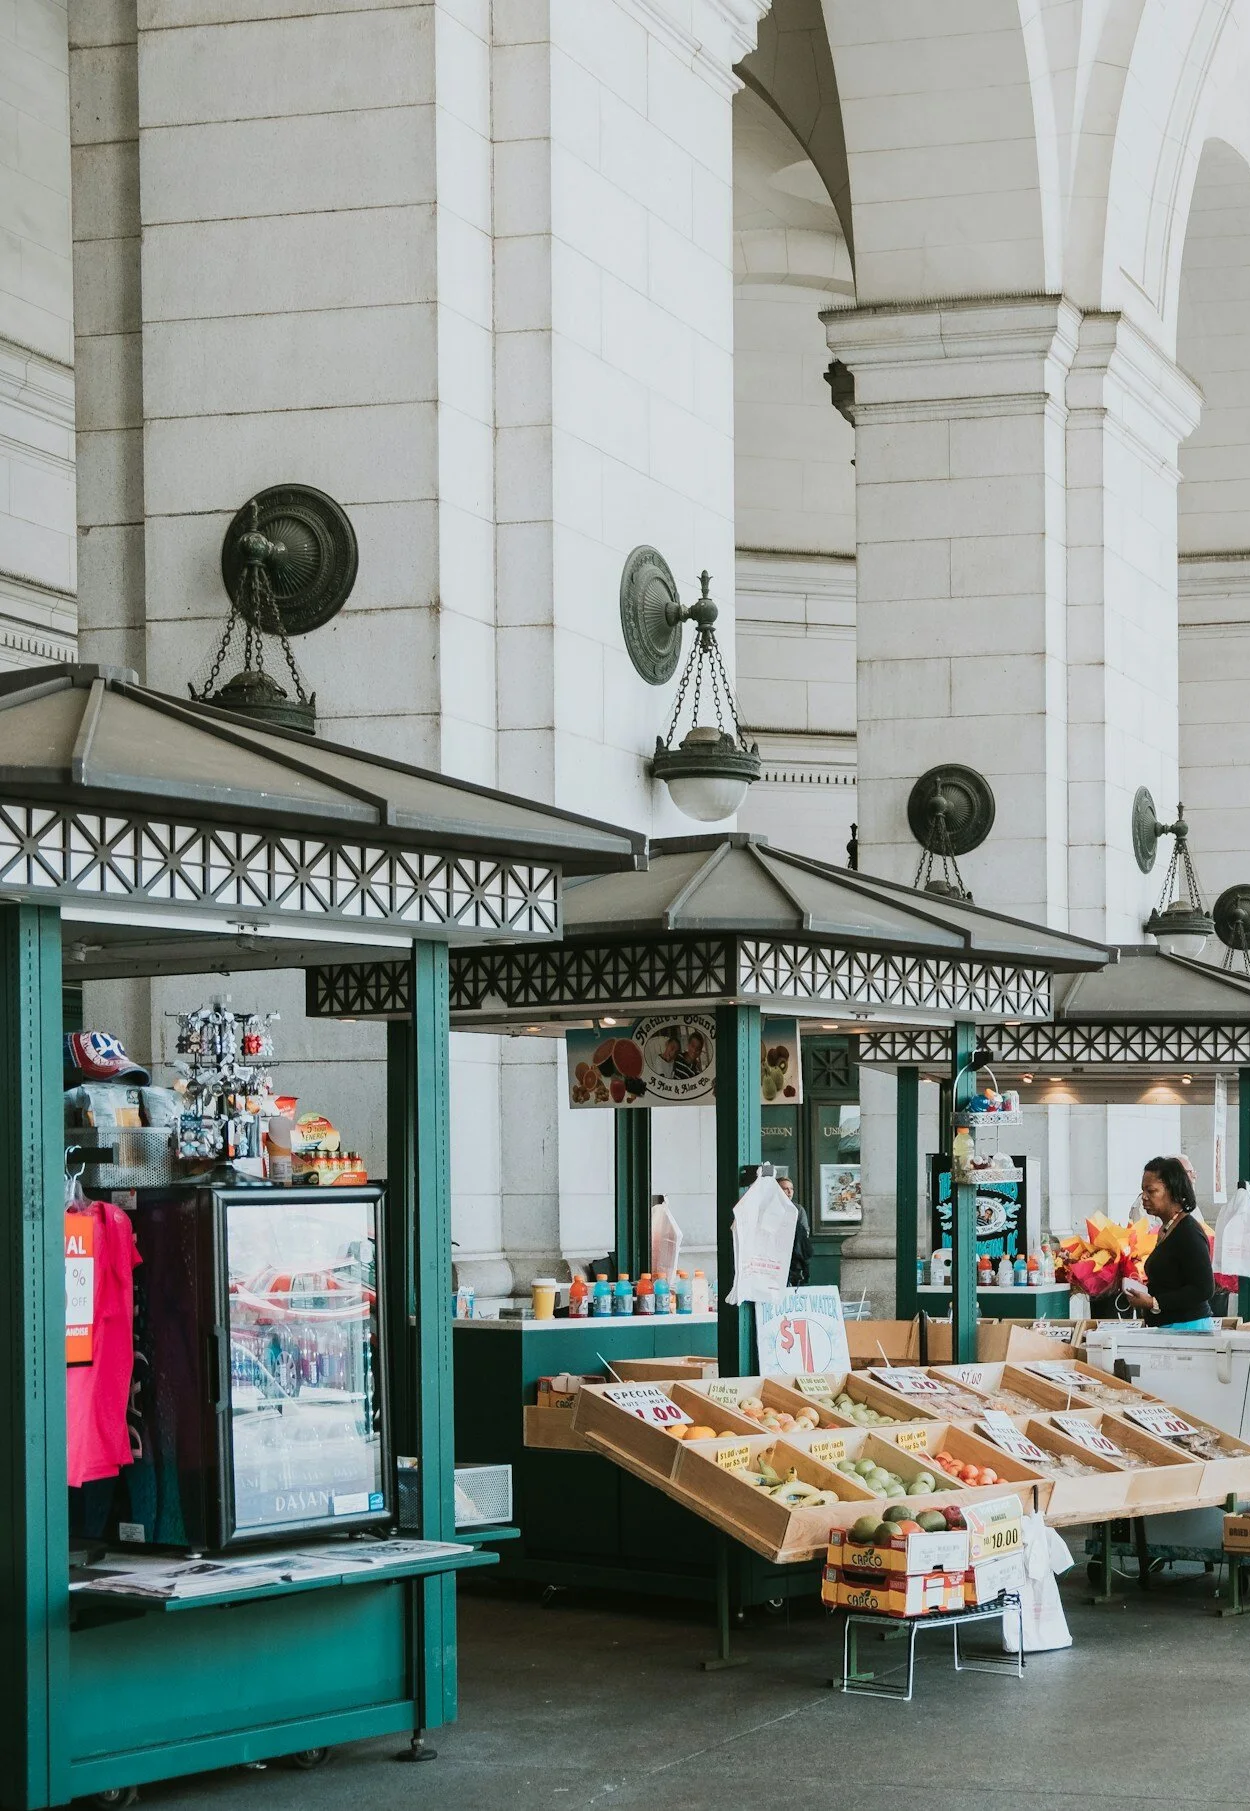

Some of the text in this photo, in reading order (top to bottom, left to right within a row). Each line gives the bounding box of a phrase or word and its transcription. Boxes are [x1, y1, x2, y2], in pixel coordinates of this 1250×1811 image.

[305, 1131, 328, 1141] ENERGY
[71, 1297, 88, 1307] OFF
[809, 1294, 840, 1321] WATER
[780, 1315, 815, 1373] $1
[613, 1389, 662, 1400] SPECIAL
[635, 1404, 683, 1422] 1.00
[1131, 1408, 1170, 1416] SPECIAL
[1151, 1421, 1190, 1433] 1.00
[1003, 1441, 1042, 1458] 1.00
[1078, 1435, 1114, 1451] 1.00
[1229, 1527, 1248, 1537] DRIED
[851, 1553, 883, 1568] CAPCO
[847, 1594, 879, 1609] CAPCO
